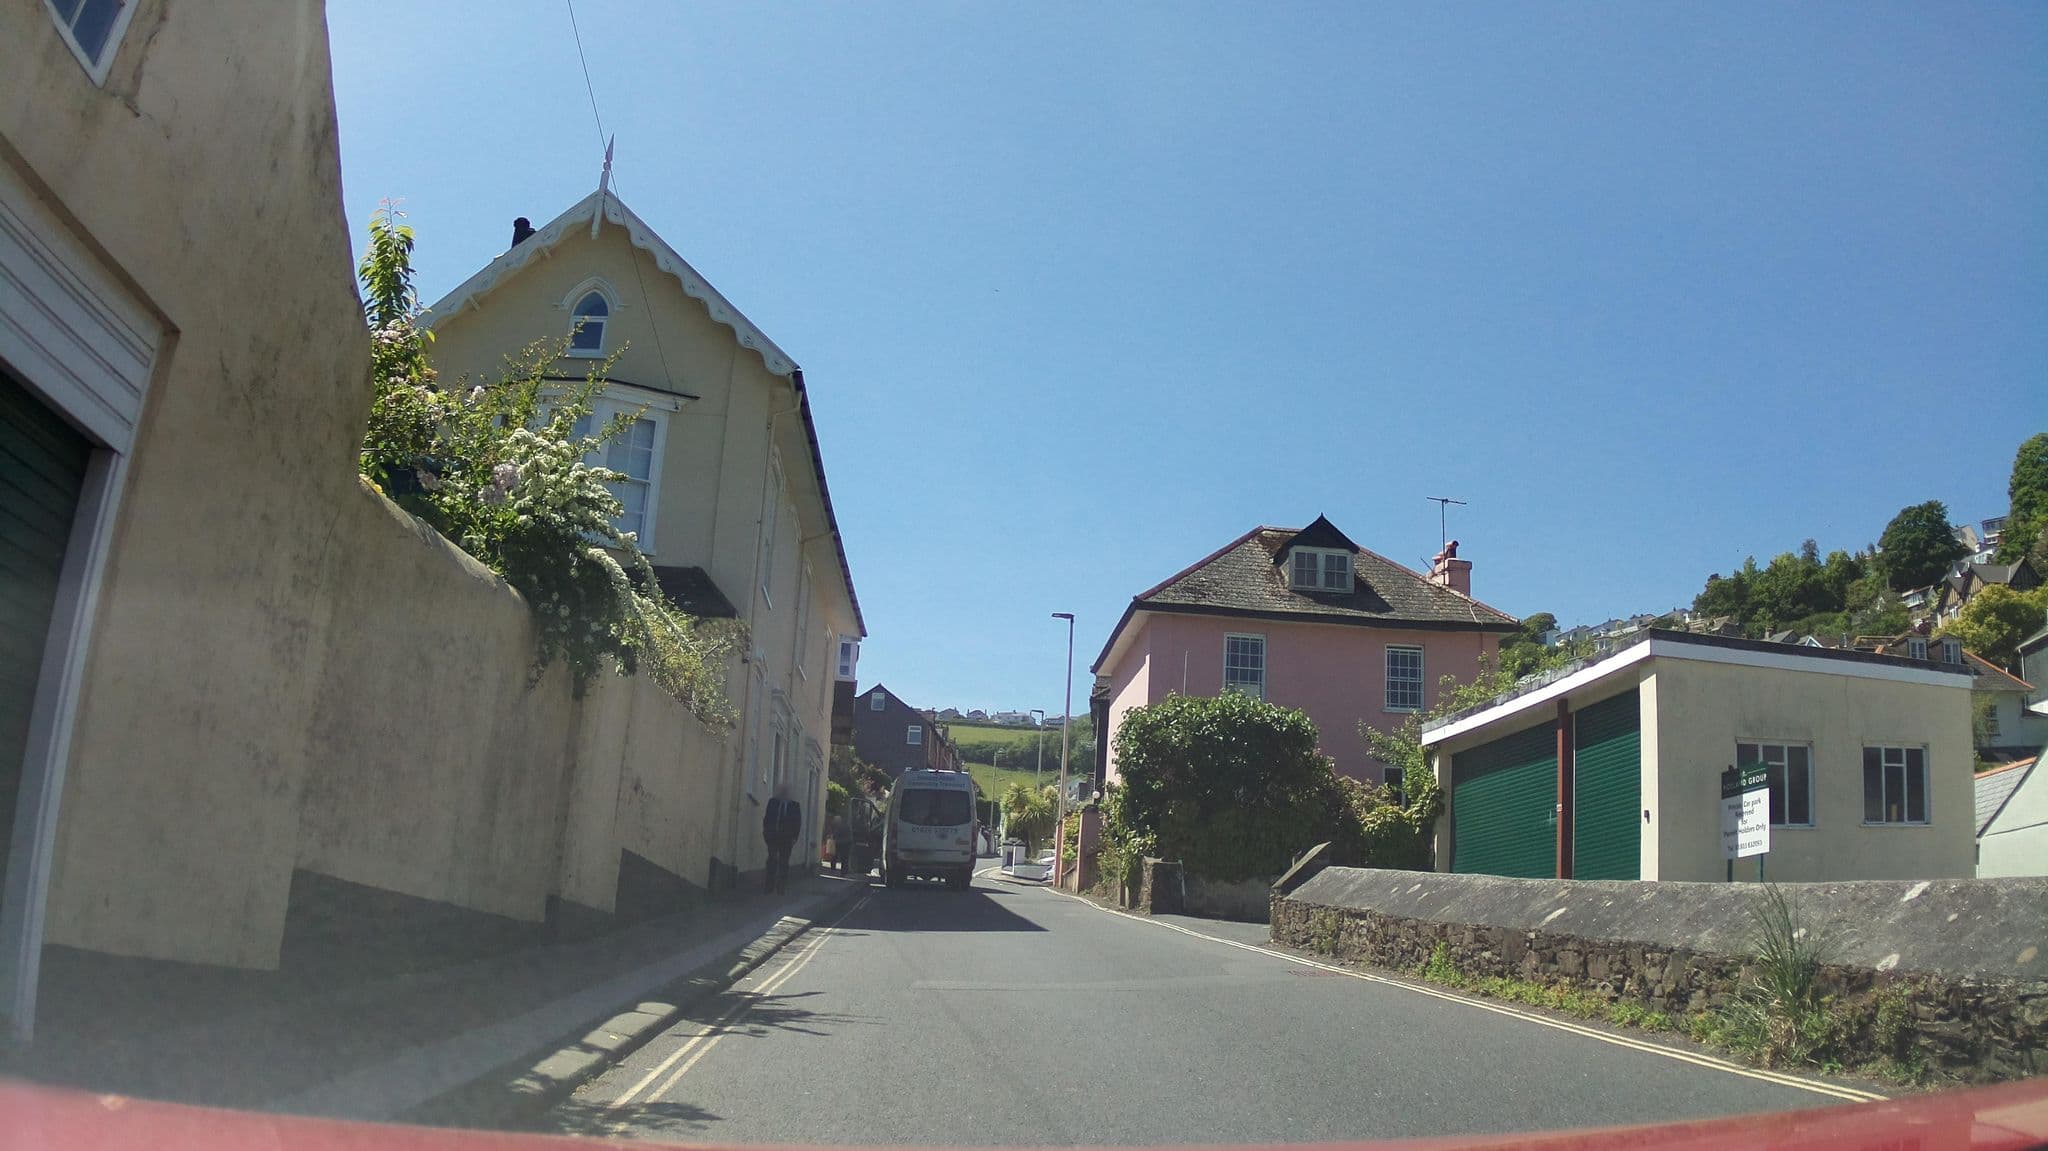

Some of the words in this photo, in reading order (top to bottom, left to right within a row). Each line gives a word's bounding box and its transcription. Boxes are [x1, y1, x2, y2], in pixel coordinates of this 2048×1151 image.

[1748, 773, 1767, 785] GROUP
[1743, 800, 1751, 808] Car
[1751, 797, 1761, 807] park
[1755, 823, 1766, 831] Only
